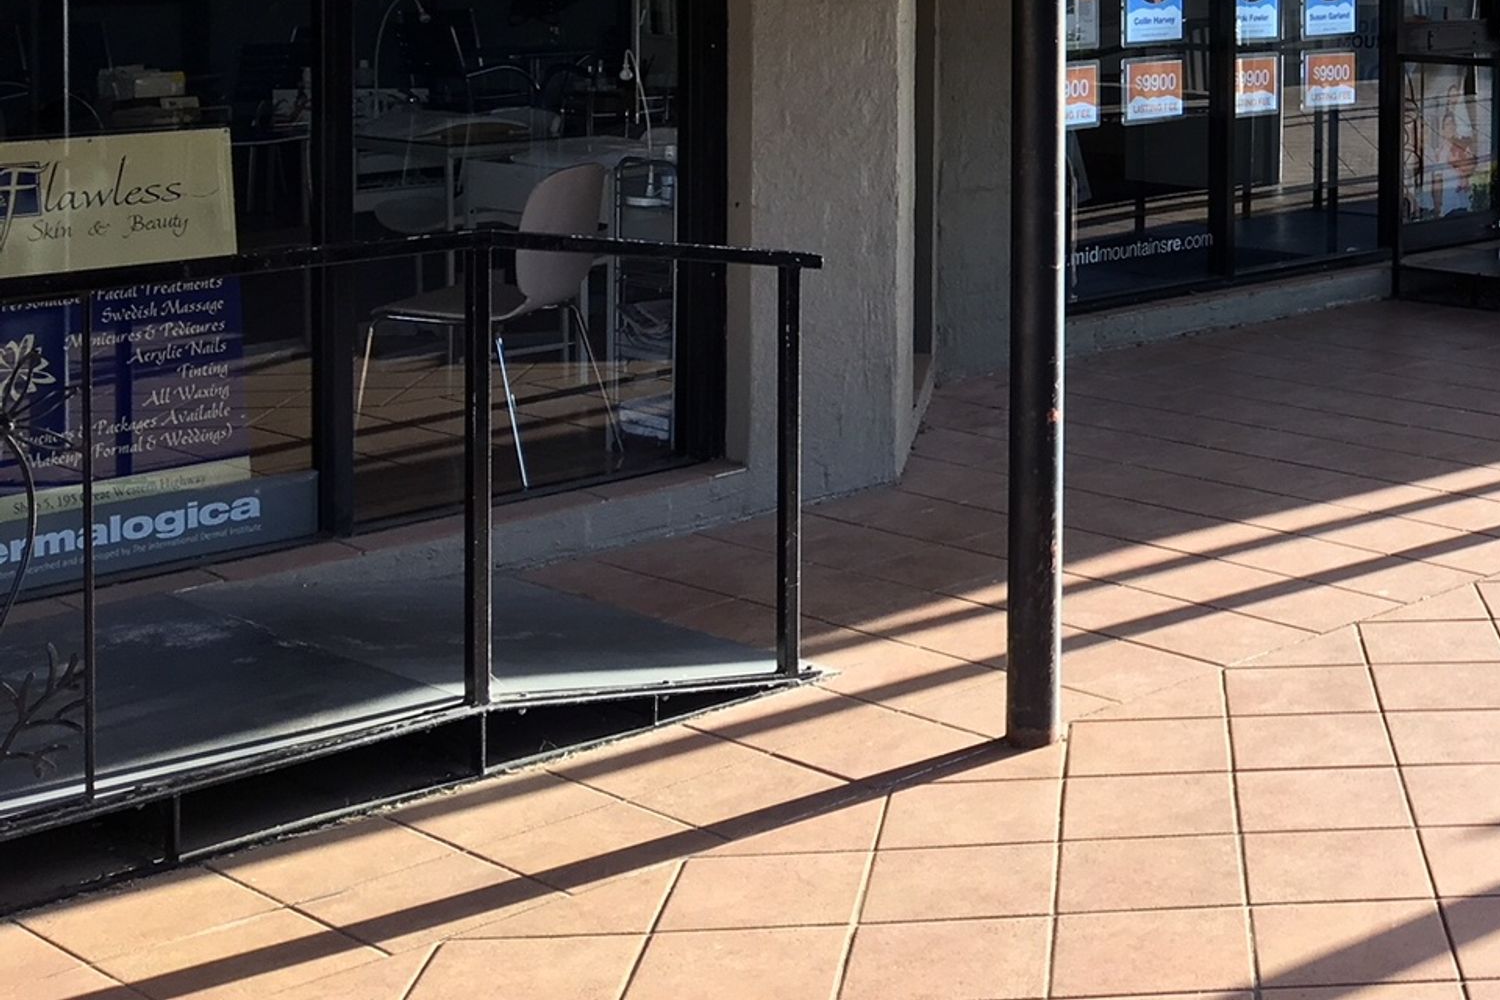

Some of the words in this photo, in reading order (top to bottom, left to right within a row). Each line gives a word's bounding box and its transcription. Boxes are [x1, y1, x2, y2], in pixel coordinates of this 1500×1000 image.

[1135, 72, 1177, 92] $9900
[1313, 63, 1350, 82] $9900
[27, 218, 73, 242] Skin
[87, 221, 111, 237] &
[122, 213, 190, 238] Beauty
[141, 278, 223, 296] Treatments
[101, 301, 158, 323] Swedish
[160, 299, 224, 316] Massage
[63, 331, 142, 351] Mnicures
[159, 320, 226, 338] Pedicures
[126, 343, 182, 366] Acrylic
[184, 336, 227, 357] Nails
[176, 362, 229, 379] Tinting
[141, 387, 170, 407] All
[172, 384, 230, 400] Waxing
[92, 416, 158, 436] Packages
[160, 401, 231, 426] Available
[145, 435, 157, 452] &
[159, 422, 233, 446] Weddings)
